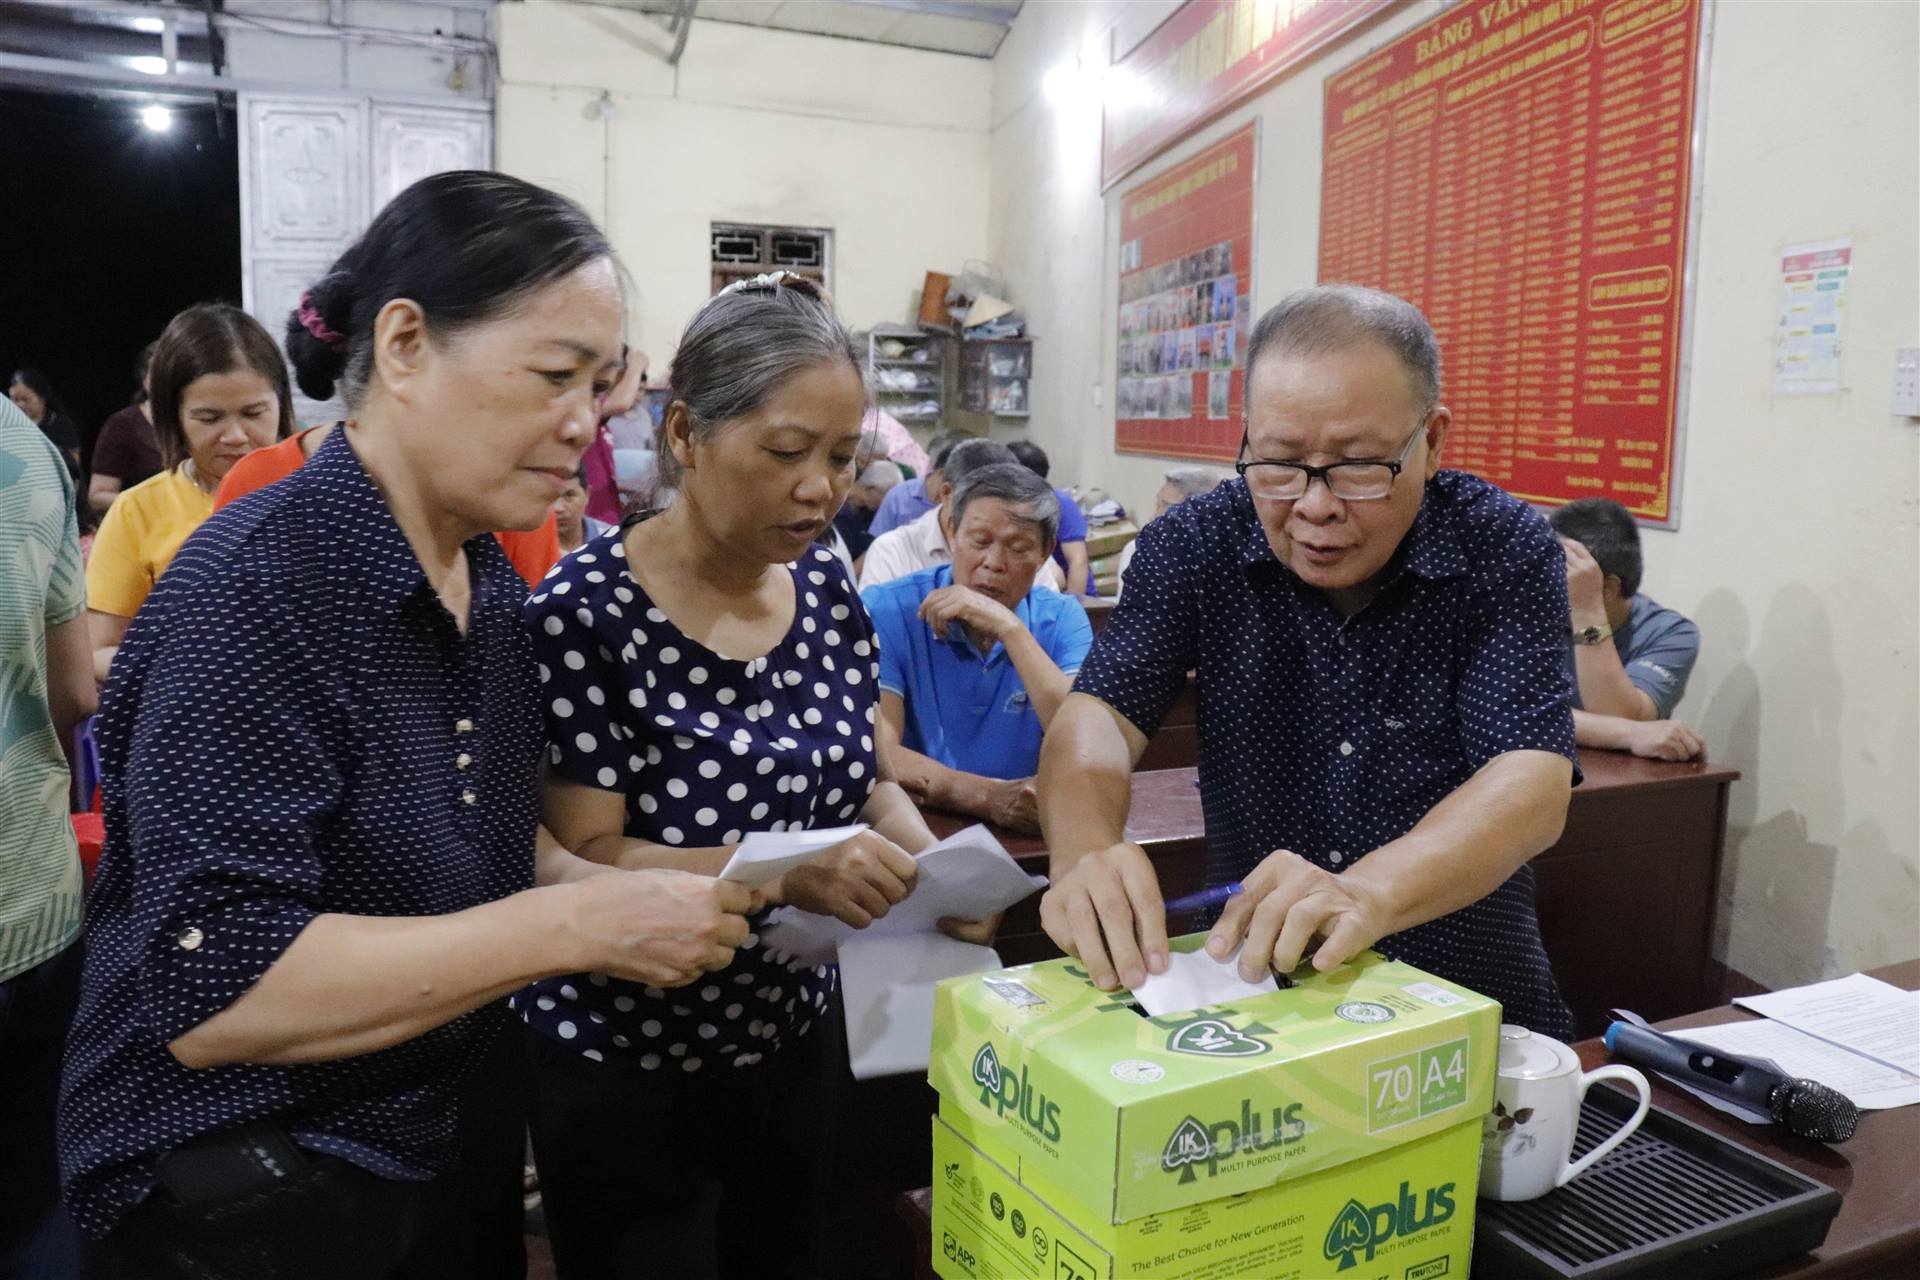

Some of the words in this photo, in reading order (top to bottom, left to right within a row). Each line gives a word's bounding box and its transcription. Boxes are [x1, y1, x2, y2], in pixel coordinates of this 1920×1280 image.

[982, 1055, 997, 1085] IK
[997, 1063, 1061, 1143] plus
[1373, 1064, 1413, 1109] 70
[1422, 1048, 1465, 1094] A4
[1178, 1132, 1203, 1154] IK
[1208, 1099, 1305, 1178] plus
[1220, 1161, 1244, 1175] MULTI
[1247, 1152, 1282, 1168] PURPOSE
[1284, 1145, 1306, 1159] PAPER
[1132, 1260, 1151, 1273] The
[1154, 1252, 1175, 1267] Best
[1178, 1241, 1212, 1259] Choice
[1214, 1237, 1228, 1249] for
[1230, 1230, 1251, 1244] New
[1254, 1213, 1305, 1237] Generation
[1341, 1217, 1364, 1240] IK
[1365, 1180, 1456, 1262] plus
[1398, 1233, 1429, 1249] PURPOSE
[1430, 1225, 1452, 1239] PAPER
[957, 1246, 976, 1269] APP
